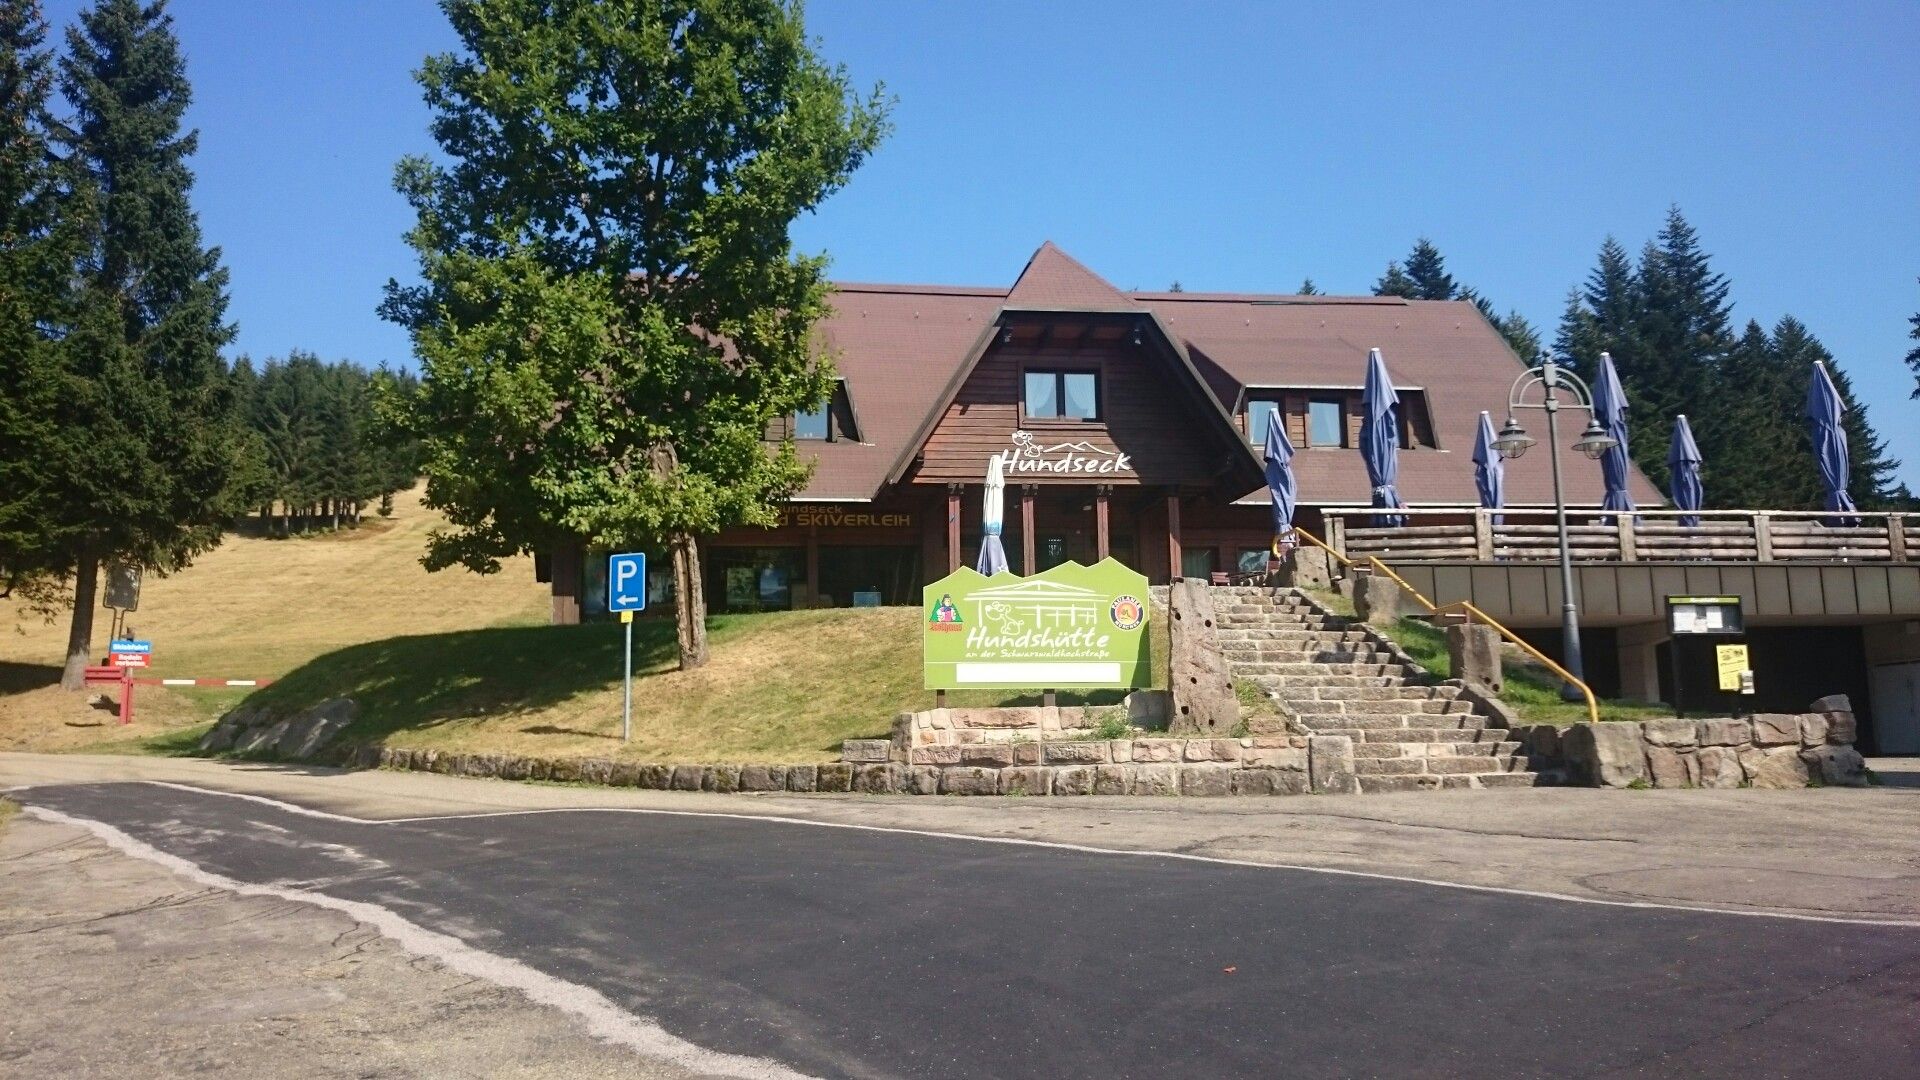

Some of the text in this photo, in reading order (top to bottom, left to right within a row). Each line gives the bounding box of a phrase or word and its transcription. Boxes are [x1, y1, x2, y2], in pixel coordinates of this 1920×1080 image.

[1001, 448, 1131, 474] Hundseck
[780, 505, 843, 514] undseck
[797, 513, 910, 527] SKIVERLEIH
[617, 560, 638, 592] P
[966, 626, 1110, 649] Hundshütte
[980, 649, 996, 657] der
[1000, 649, 1110, 660] Schwarzwaldhochstraße
